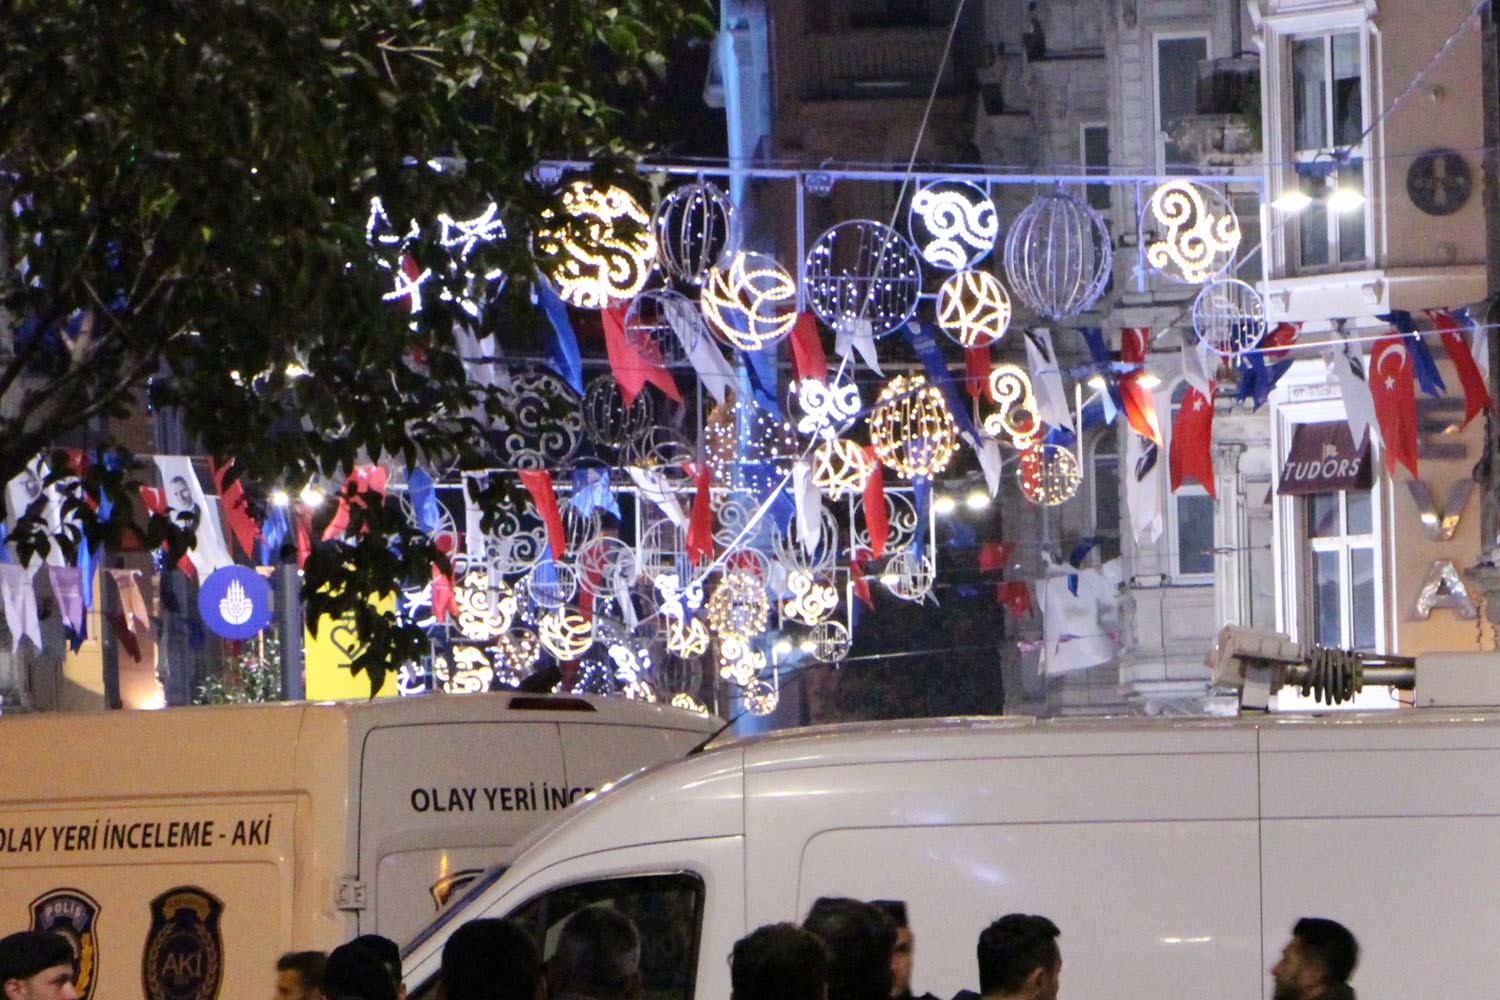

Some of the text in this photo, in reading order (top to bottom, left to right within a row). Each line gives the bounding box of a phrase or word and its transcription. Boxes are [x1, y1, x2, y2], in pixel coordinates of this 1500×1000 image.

[1283, 457, 1362, 481] TUDORS
[410, 787, 477, 812] OLAY
[483, 782, 537, 811] YERİ
[53, 818, 99, 850] YERİ
[103, 819, 214, 850] İNCELEME
[231, 814, 273, 845] AKİ
